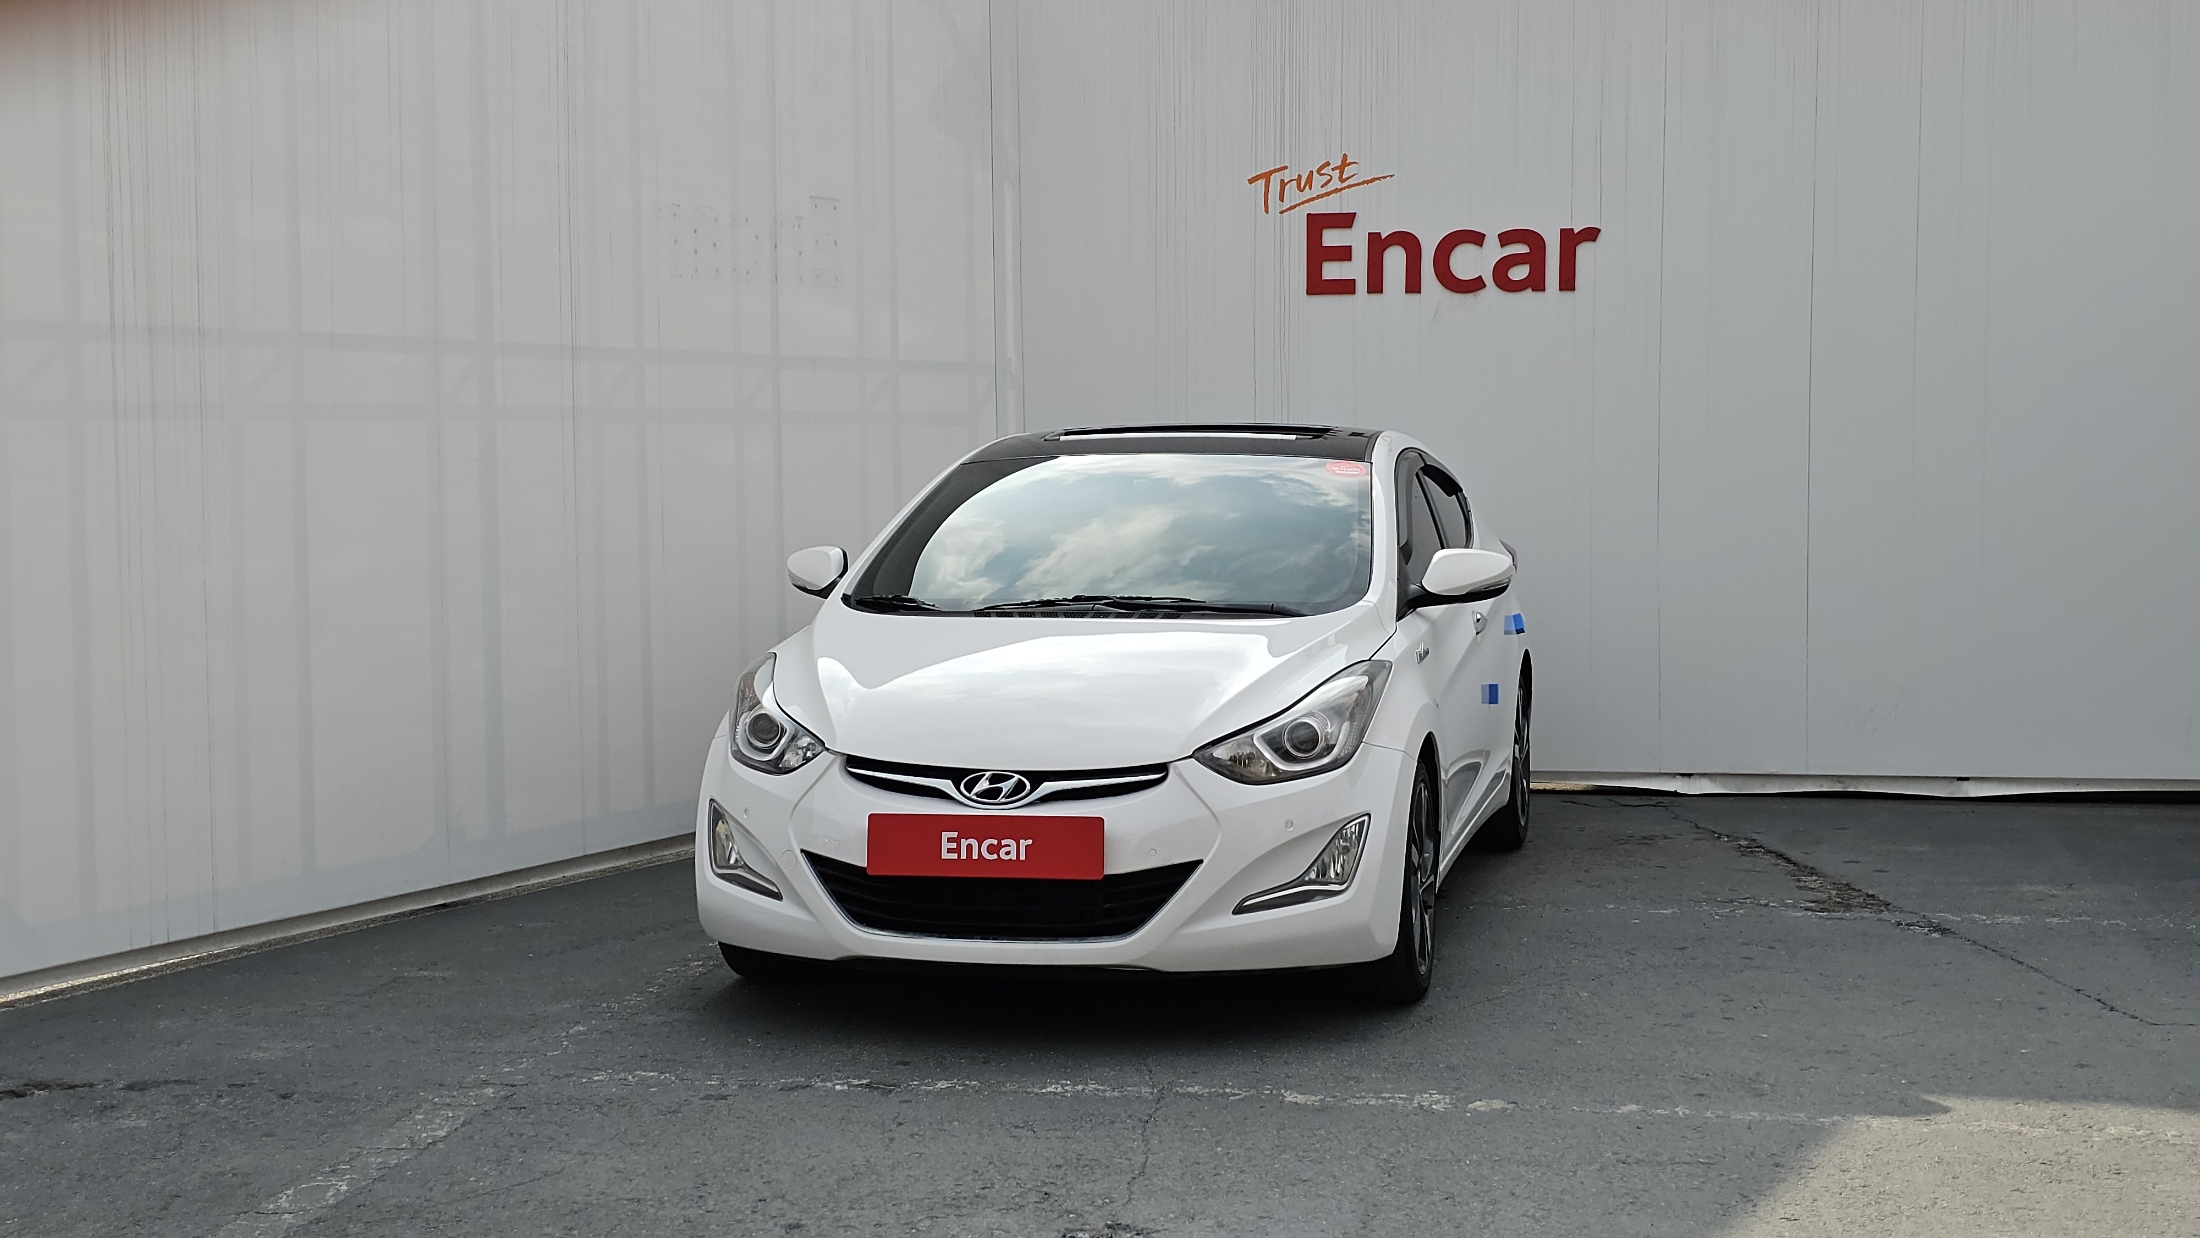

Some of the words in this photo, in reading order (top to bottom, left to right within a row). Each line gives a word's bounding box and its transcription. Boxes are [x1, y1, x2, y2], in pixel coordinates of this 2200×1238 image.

[1247, 153, 1360, 214] Trust
[1306, 212, 1602, 296] Encar
[941, 831, 1033, 861] Encar
